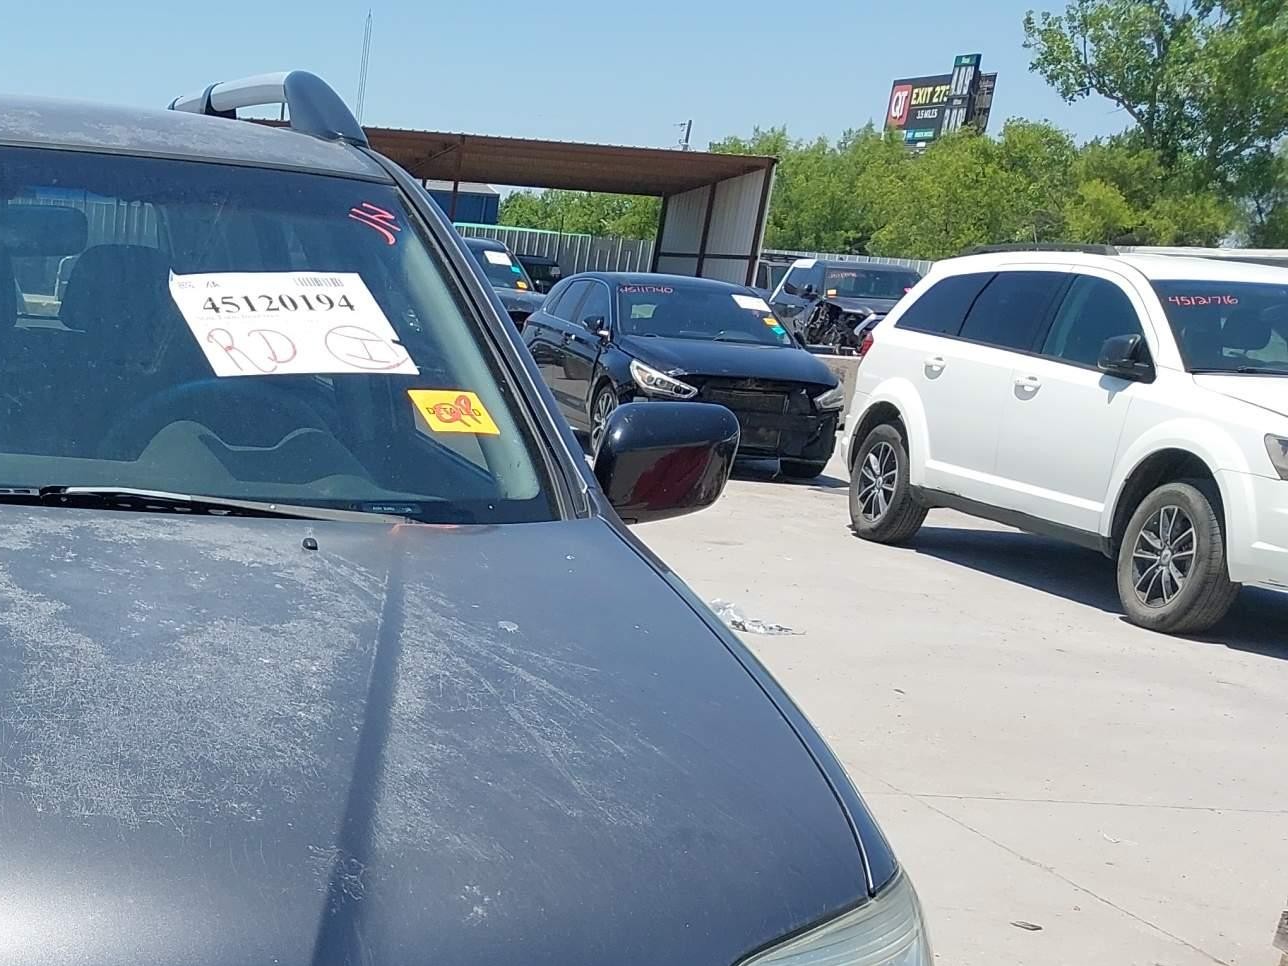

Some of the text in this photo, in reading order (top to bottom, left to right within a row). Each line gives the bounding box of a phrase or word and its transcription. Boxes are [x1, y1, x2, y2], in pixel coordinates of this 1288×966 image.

[891, 91, 909, 120] QT
[911, 87, 933, 105] EXIT
[202, 293, 356, 313] 45120194
